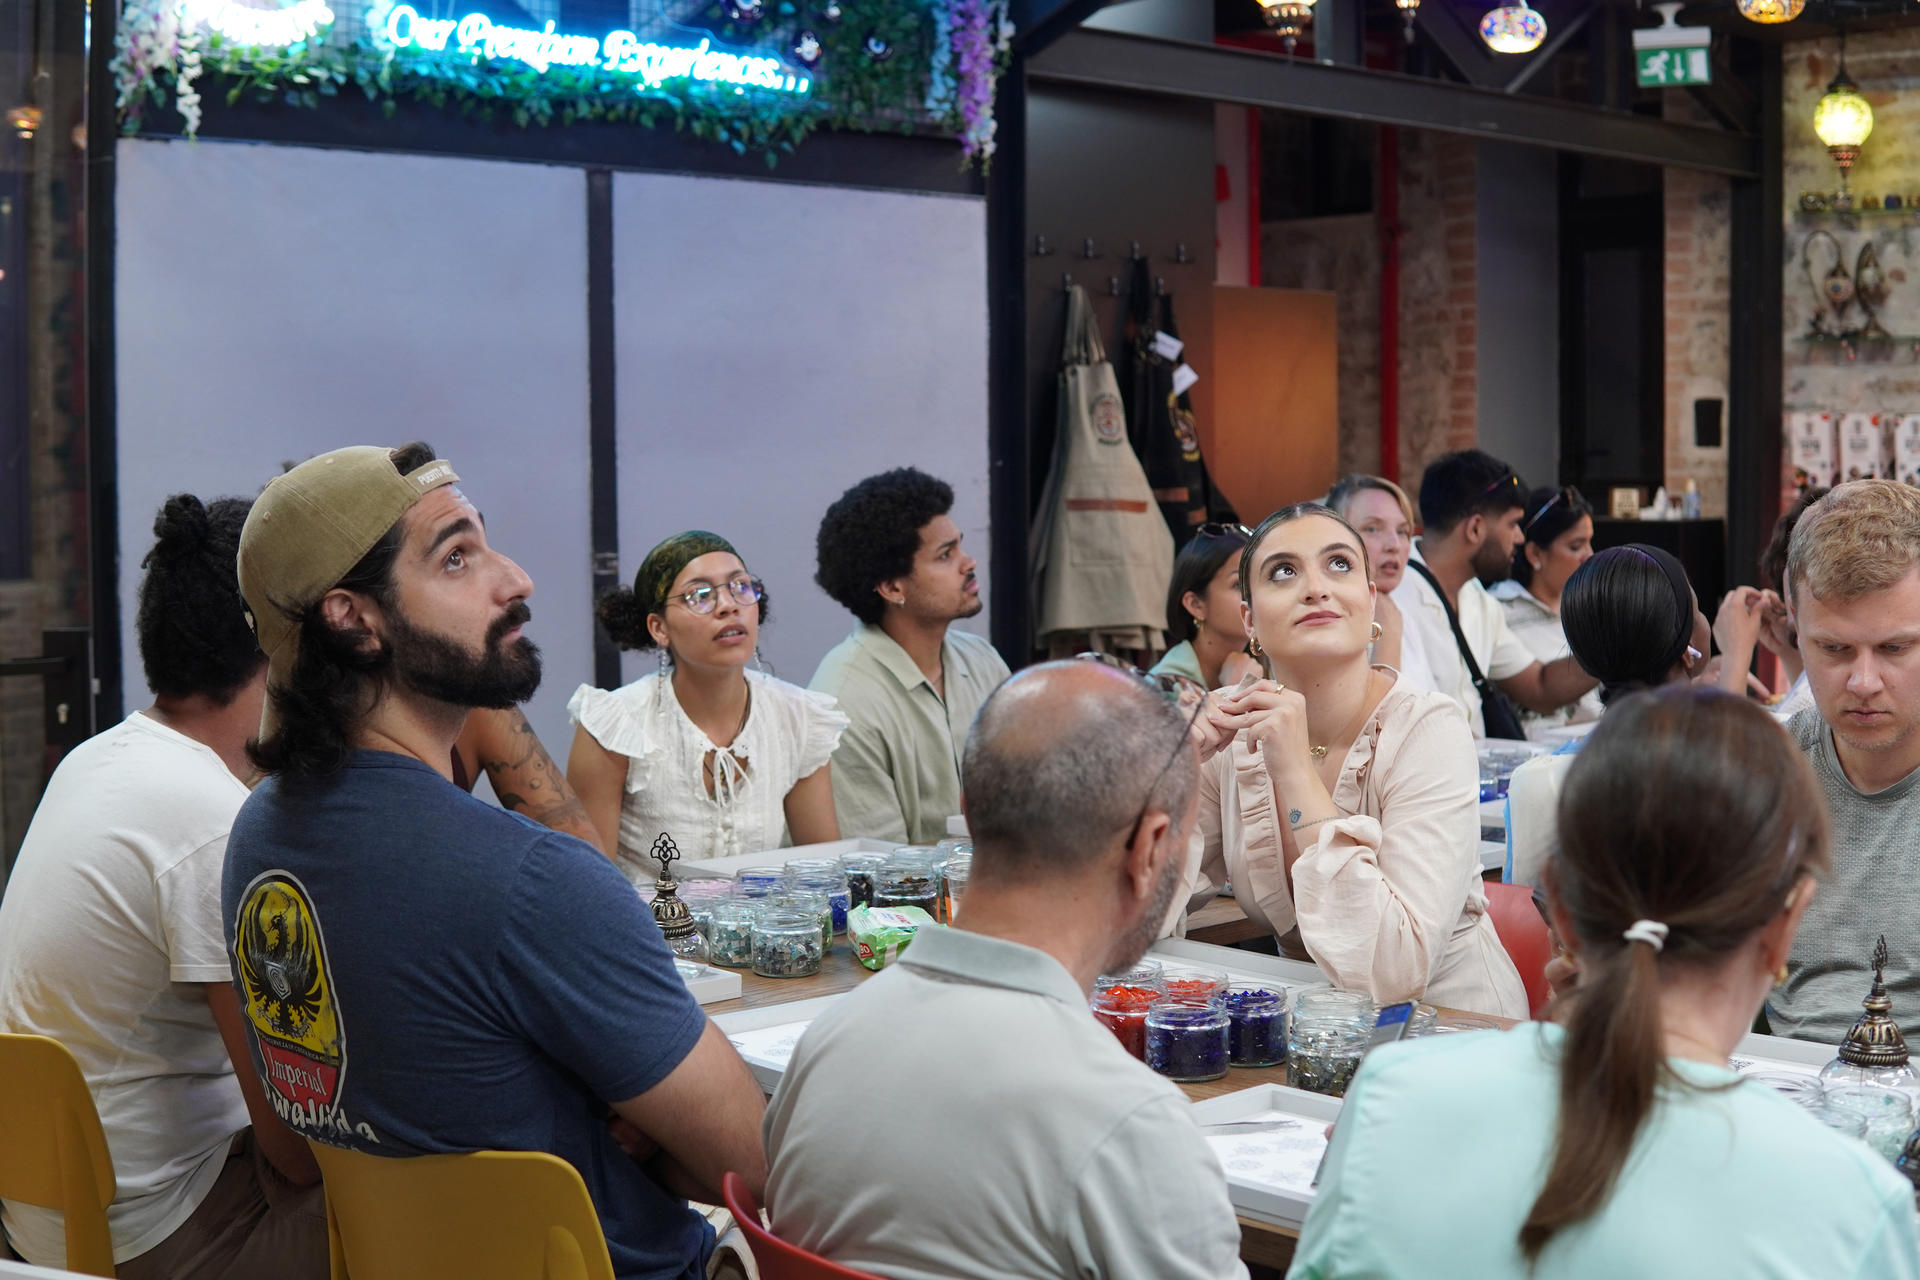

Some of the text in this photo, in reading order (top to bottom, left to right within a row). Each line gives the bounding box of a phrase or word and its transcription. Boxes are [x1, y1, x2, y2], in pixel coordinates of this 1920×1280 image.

[387, 4, 457, 51] Our
[457, 13, 601, 74] Premium
[266, 1047, 327, 1097] Imperial
